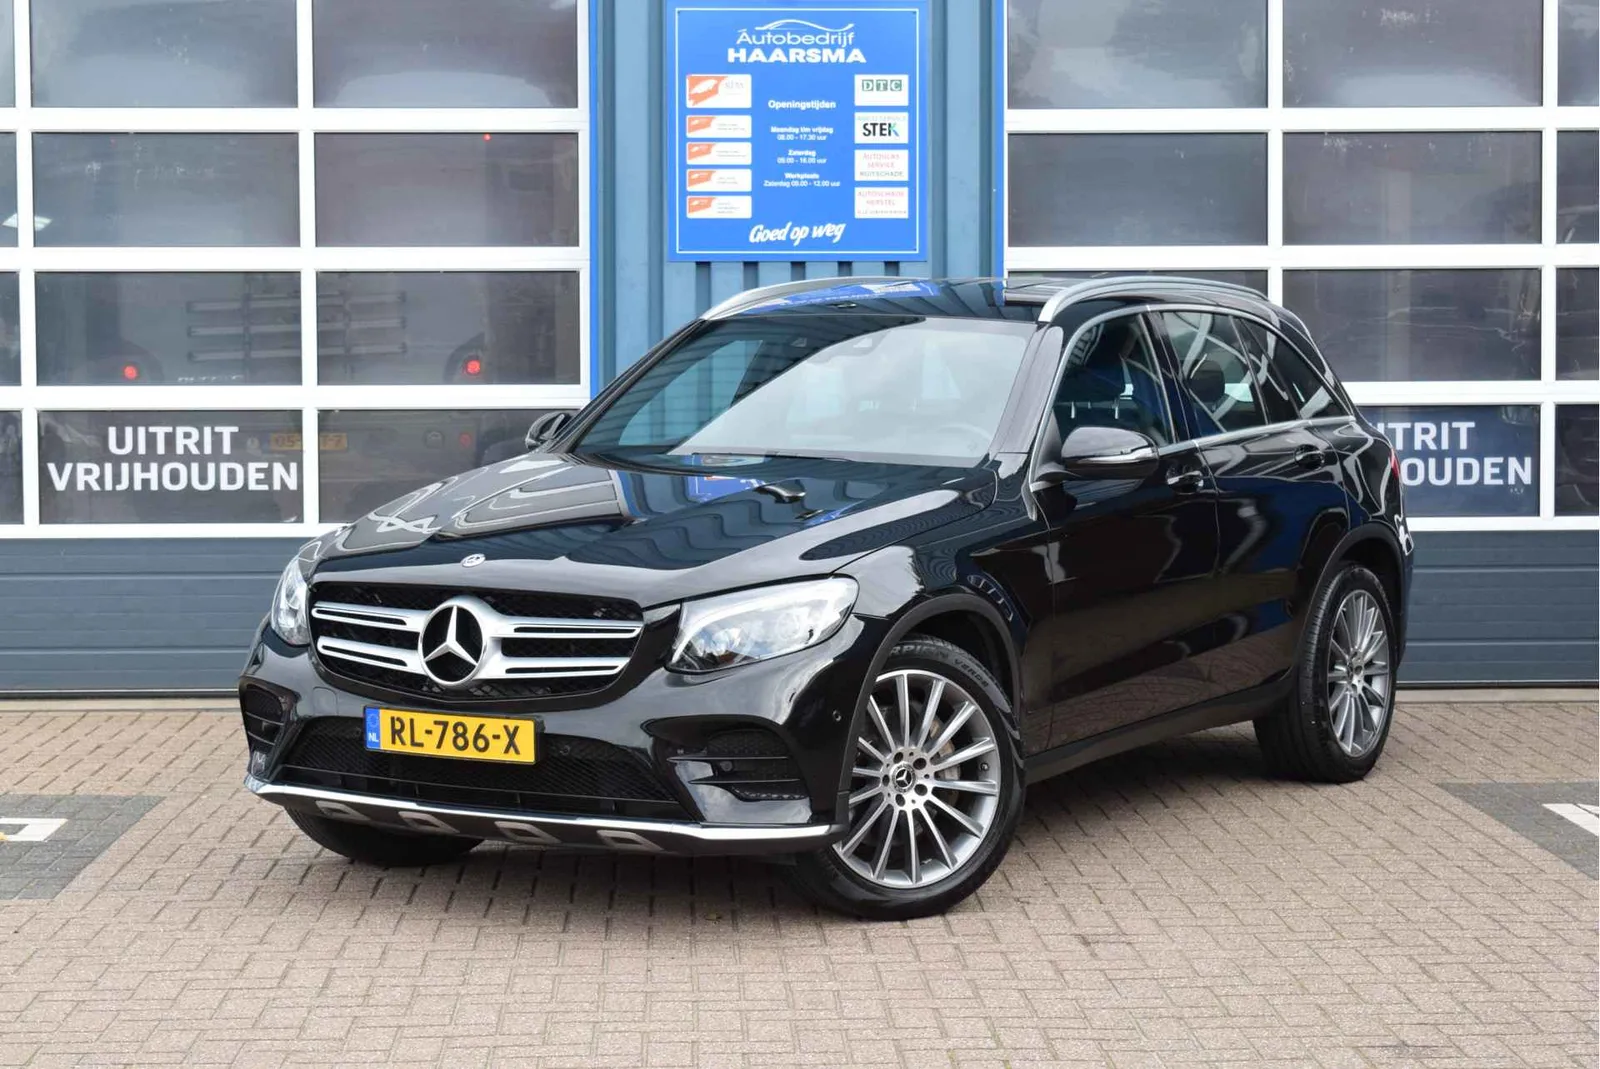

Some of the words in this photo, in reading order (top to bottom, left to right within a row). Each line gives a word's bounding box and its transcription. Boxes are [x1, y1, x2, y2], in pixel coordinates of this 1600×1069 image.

[728, 48, 867, 63] HAARSMA
[862, 79, 902, 91] DTC
[768, 99, 837, 110] Openingstijden
[862, 122, 900, 137] STEK
[749, 221, 792, 243] Goed
[790, 226, 810, 246] op
[811, 223, 846, 244] weg
[108, 426, 239, 455] UITRIT
[1377, 422, 1476, 450] TRIT
[47, 462, 298, 491] VRIJHOUDEN
[1400, 456, 1532, 486] OUDEN
[368, 732, 380, 743] NL
[390, 716, 520, 755] RL-786-X
